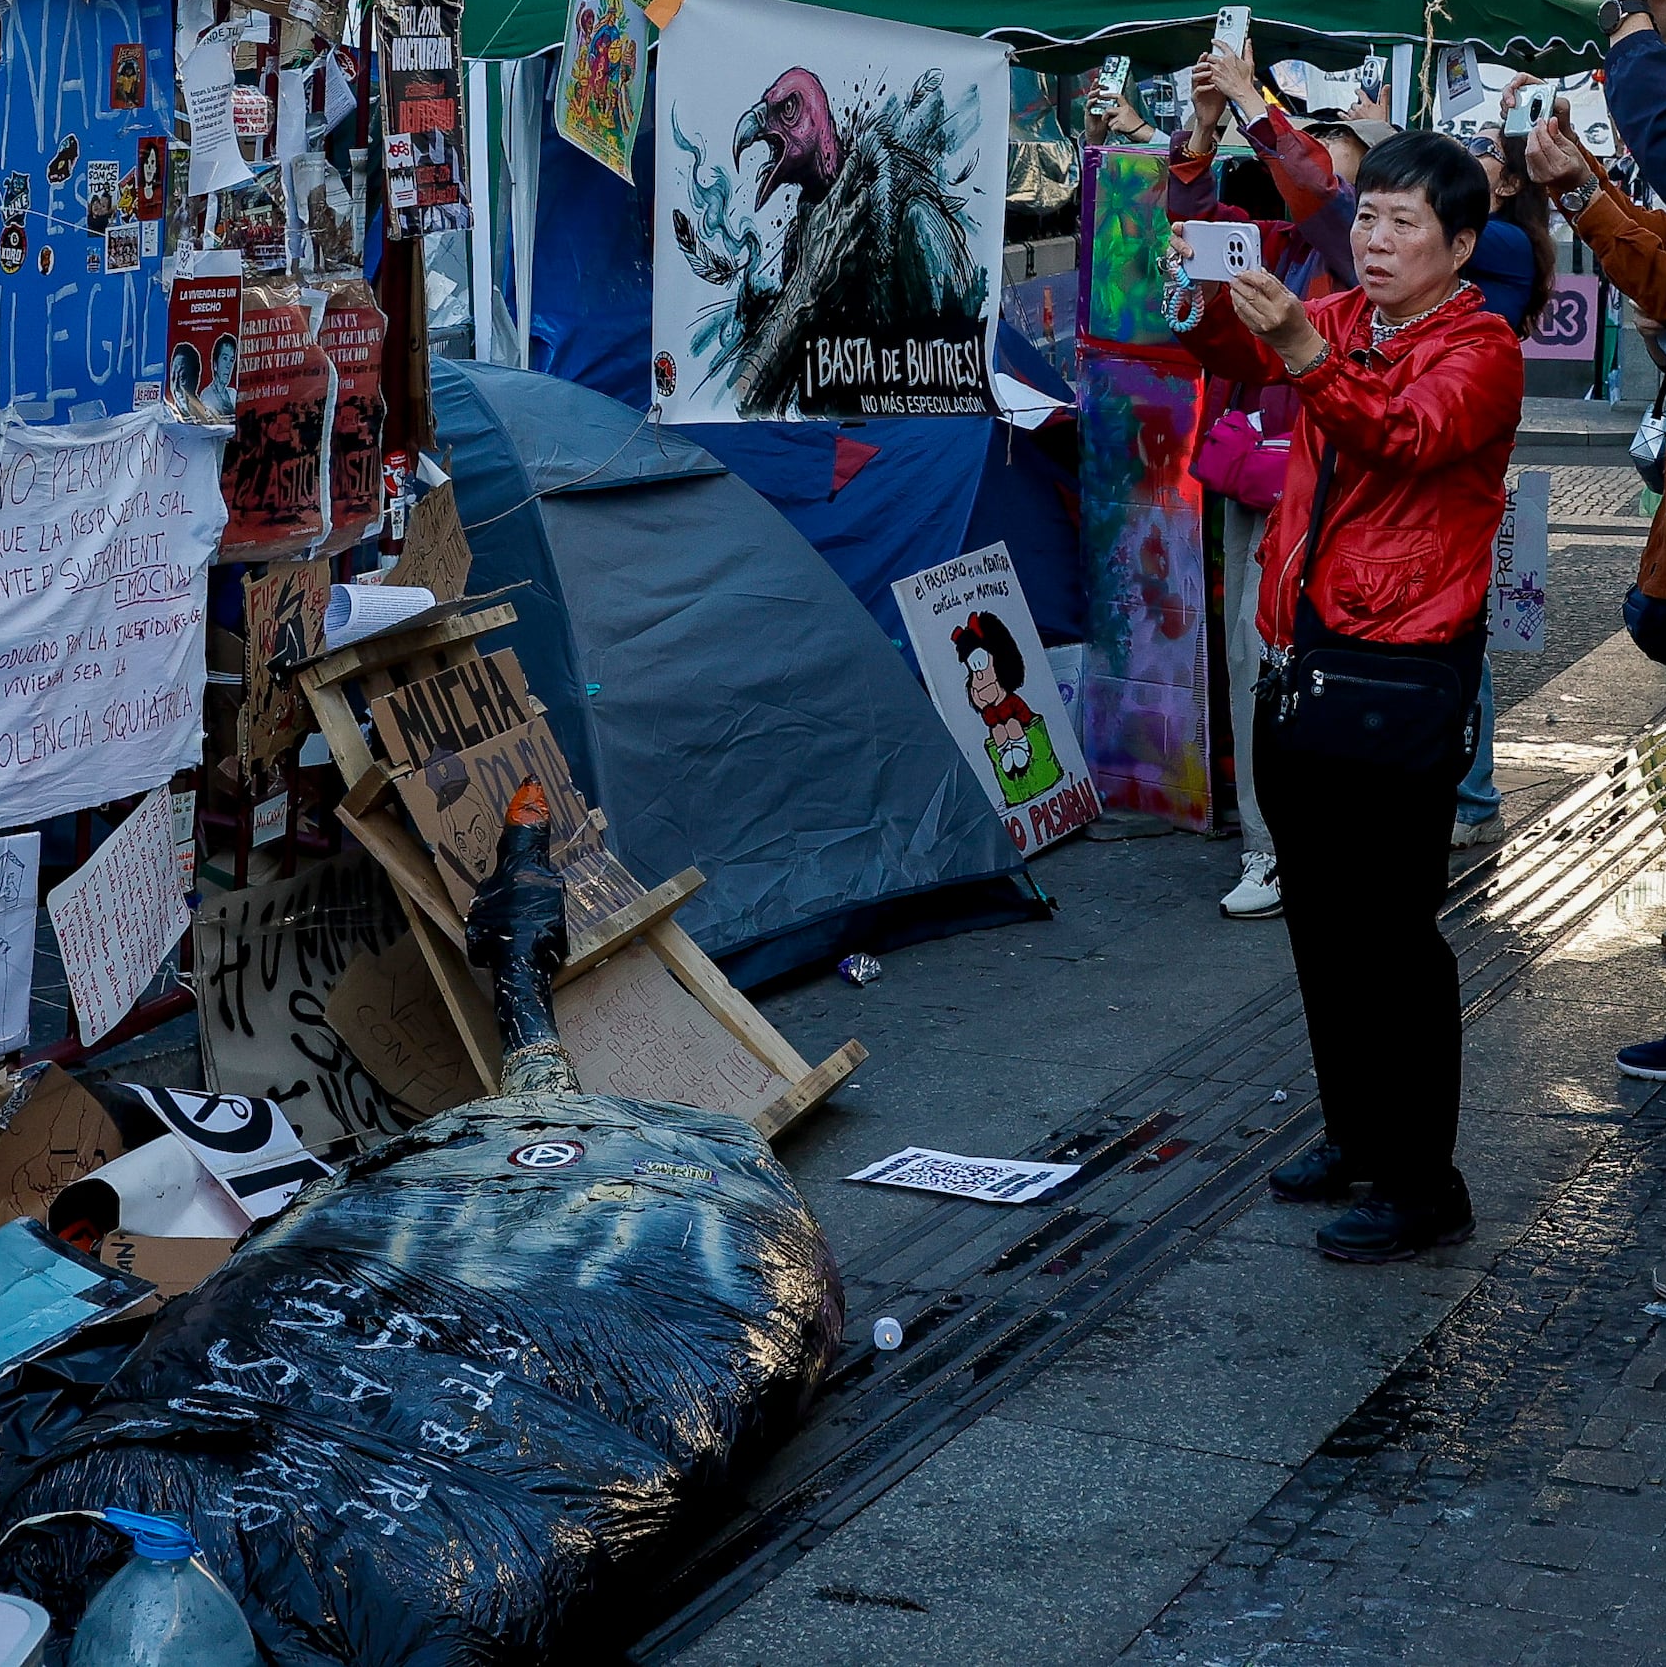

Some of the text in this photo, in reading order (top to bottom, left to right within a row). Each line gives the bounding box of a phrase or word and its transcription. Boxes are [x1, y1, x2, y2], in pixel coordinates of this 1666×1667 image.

[190, 302, 222, 313] DERECHO
[805, 335, 983, 398] ¡BASTA DE BUITRES!
[861, 390, 987, 414] NO MÁS ESPECULACIÓN
[39, 523, 62, 553] LA
[1495, 488, 1519, 589] PROTESTA
[915, 553, 1013, 601] el FASCISMO MENTIRA
[963, 580, 1010, 607] por MATONES
[87, 626, 109, 651] LA
[72, 661, 102, 681] SEA
[388, 657, 528, 769] MUCHA
[1030, 772, 1099, 845] PASARÁN
